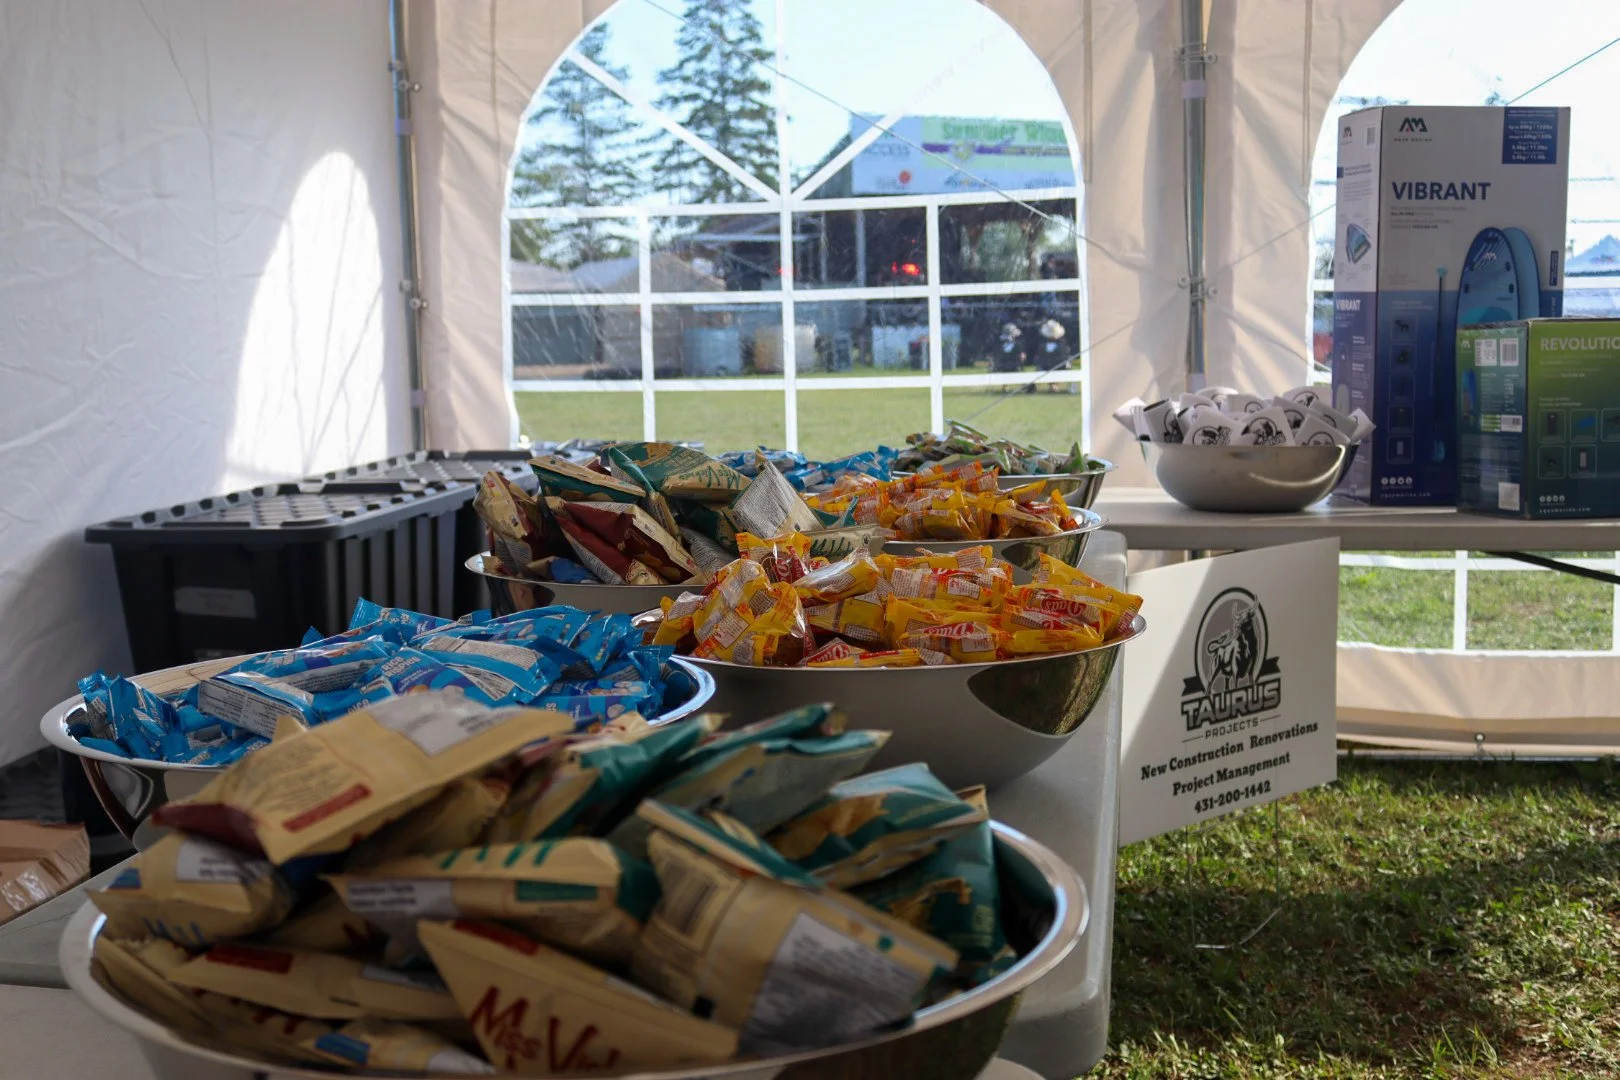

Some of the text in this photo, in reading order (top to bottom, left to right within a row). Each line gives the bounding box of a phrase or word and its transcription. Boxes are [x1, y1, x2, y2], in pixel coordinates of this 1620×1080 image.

[1391, 181, 1491, 201] VIBRANT
[1336, 299, 1361, 311] VIBRANT
[1181, 678, 1281, 732] TAURUS
[1205, 718, 1259, 740] PROJECTS
[1141, 721, 1319, 781] New Construction Renovations
[1173, 751, 1291, 797] Project Management
[1194, 780, 1272, 814] 431-200-1442
